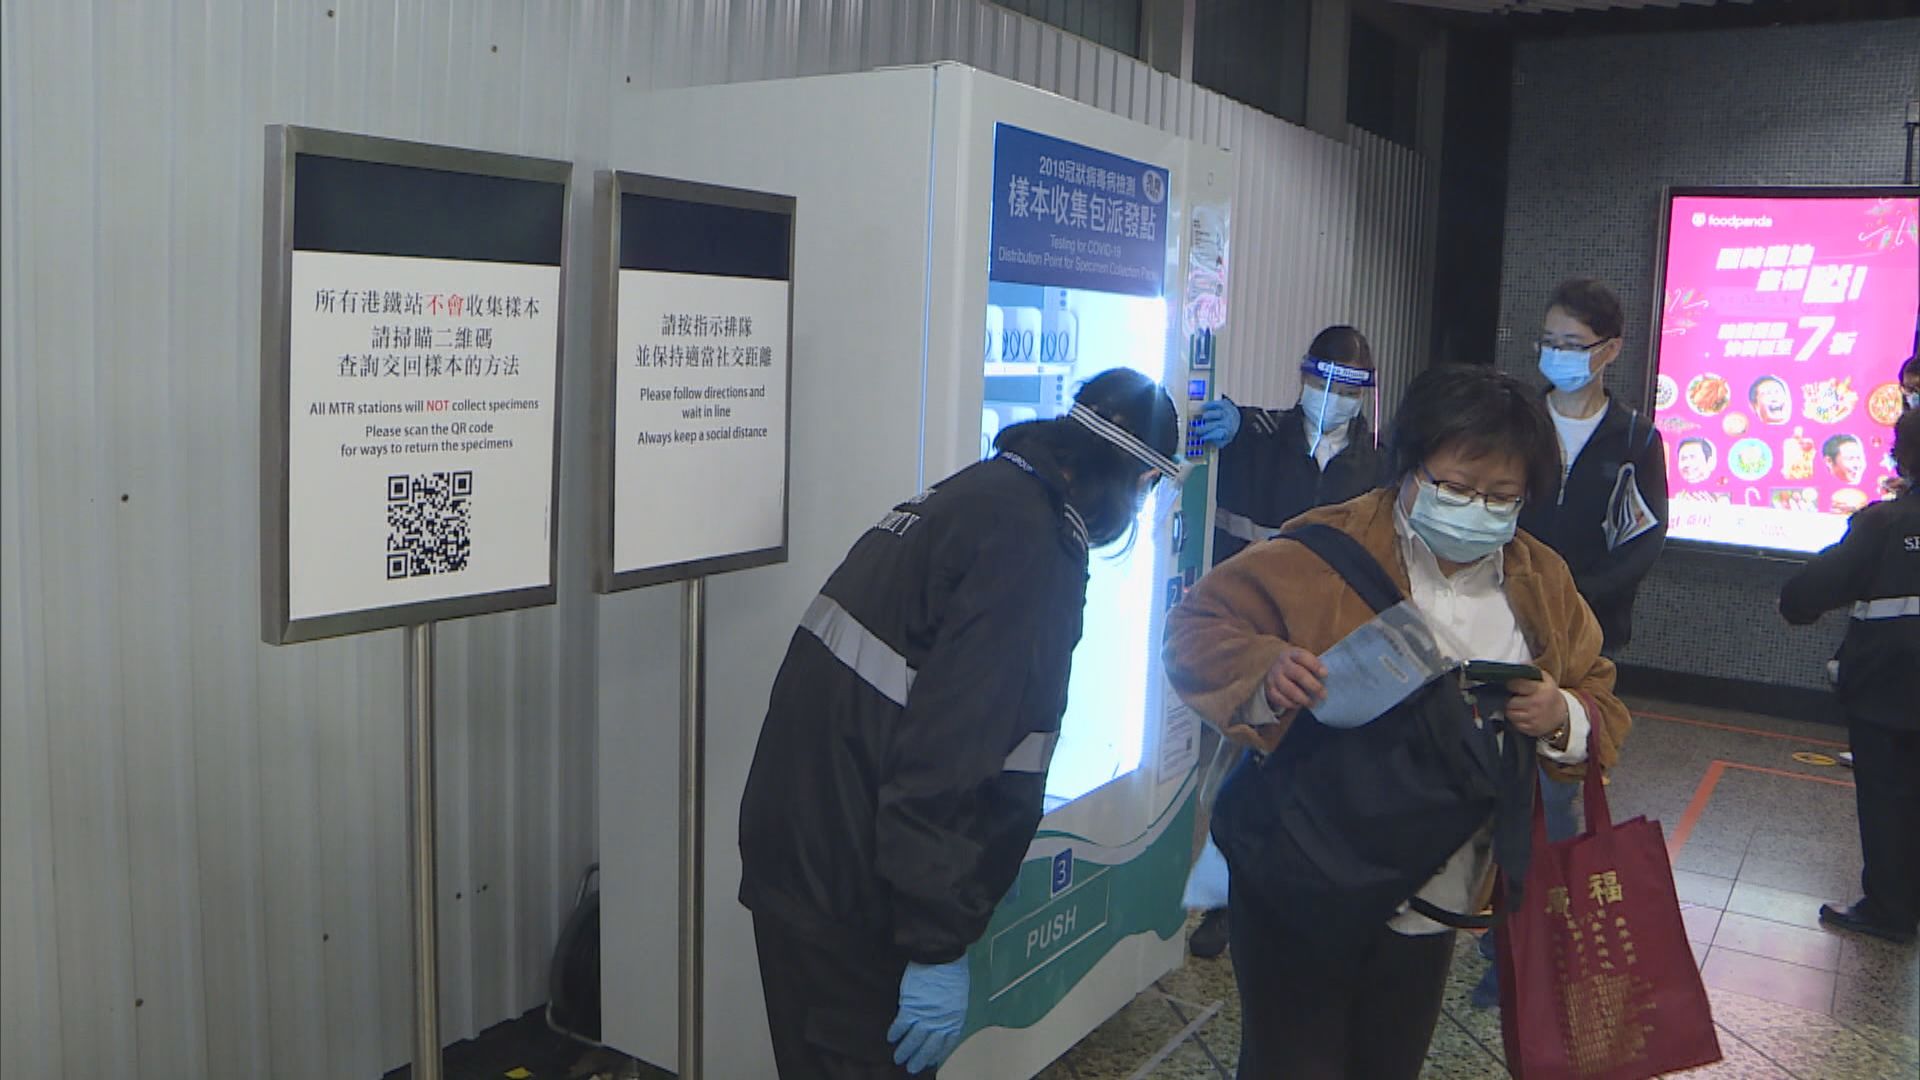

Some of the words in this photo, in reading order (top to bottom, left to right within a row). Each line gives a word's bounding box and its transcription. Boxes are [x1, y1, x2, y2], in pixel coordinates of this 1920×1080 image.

[1008, 174, 1157, 241] 樣本收集包派發點
[1708, 213, 1773, 229] foodpanda
[1050, 234, 1075, 251] Testing
[1077, 240, 1087, 250] for
[1088, 240, 1121, 258] COVID-19
[999, 247, 1042, 265] Distribution
[1044, 252, 1062, 266] Point
[1064, 254, 1074, 267] for
[1075, 256, 1109, 273] Specimen
[315, 289, 539, 319] 所有港鐵站不會收集樣本
[661, 314, 752, 337] 請按指示排隊
[371, 325, 493, 350] 請掃瞄二維碼
[337, 354, 520, 377] 查詢交回樣本的方法
[635, 344, 772, 367] 並保持適當社交距離
[640, 387, 671, 401] Please
[673, 386, 701, 400] follow
[704, 385, 748, 398] directions
[749, 384, 765, 397] and
[310, 402, 325, 415] All
[328, 402, 355, 415] MTR
[357, 401, 402, 414] stations
[405, 400, 424, 412] will
[426, 400, 449, 411] NOT
[452, 398, 486, 411] collect
[488, 398, 539, 413] specimens
[681, 405, 702, 419] wait
[704, 405, 712, 418] in
[714, 404, 731, 417] line
[366, 425, 401, 438] Please
[404, 425, 428, 436] scan
[431, 423, 449, 435] the
[451, 422, 467, 435] QR
[469, 421, 494, 433] code
[638, 431, 671, 446] Always
[674, 430, 697, 444] keep
[706, 427, 731, 440] social
[733, 426, 768, 439] distance
[341, 444, 357, 457] for
[360, 444, 388, 458] ways
[391, 442, 401, 454] to
[405, 442, 438, 453] return
[441, 440, 458, 451] the
[460, 438, 513, 453] specimens
[1057, 860, 1066, 884] 3
[1588, 870, 1623, 906] 福
[1027, 905, 1077, 958] PUSH
